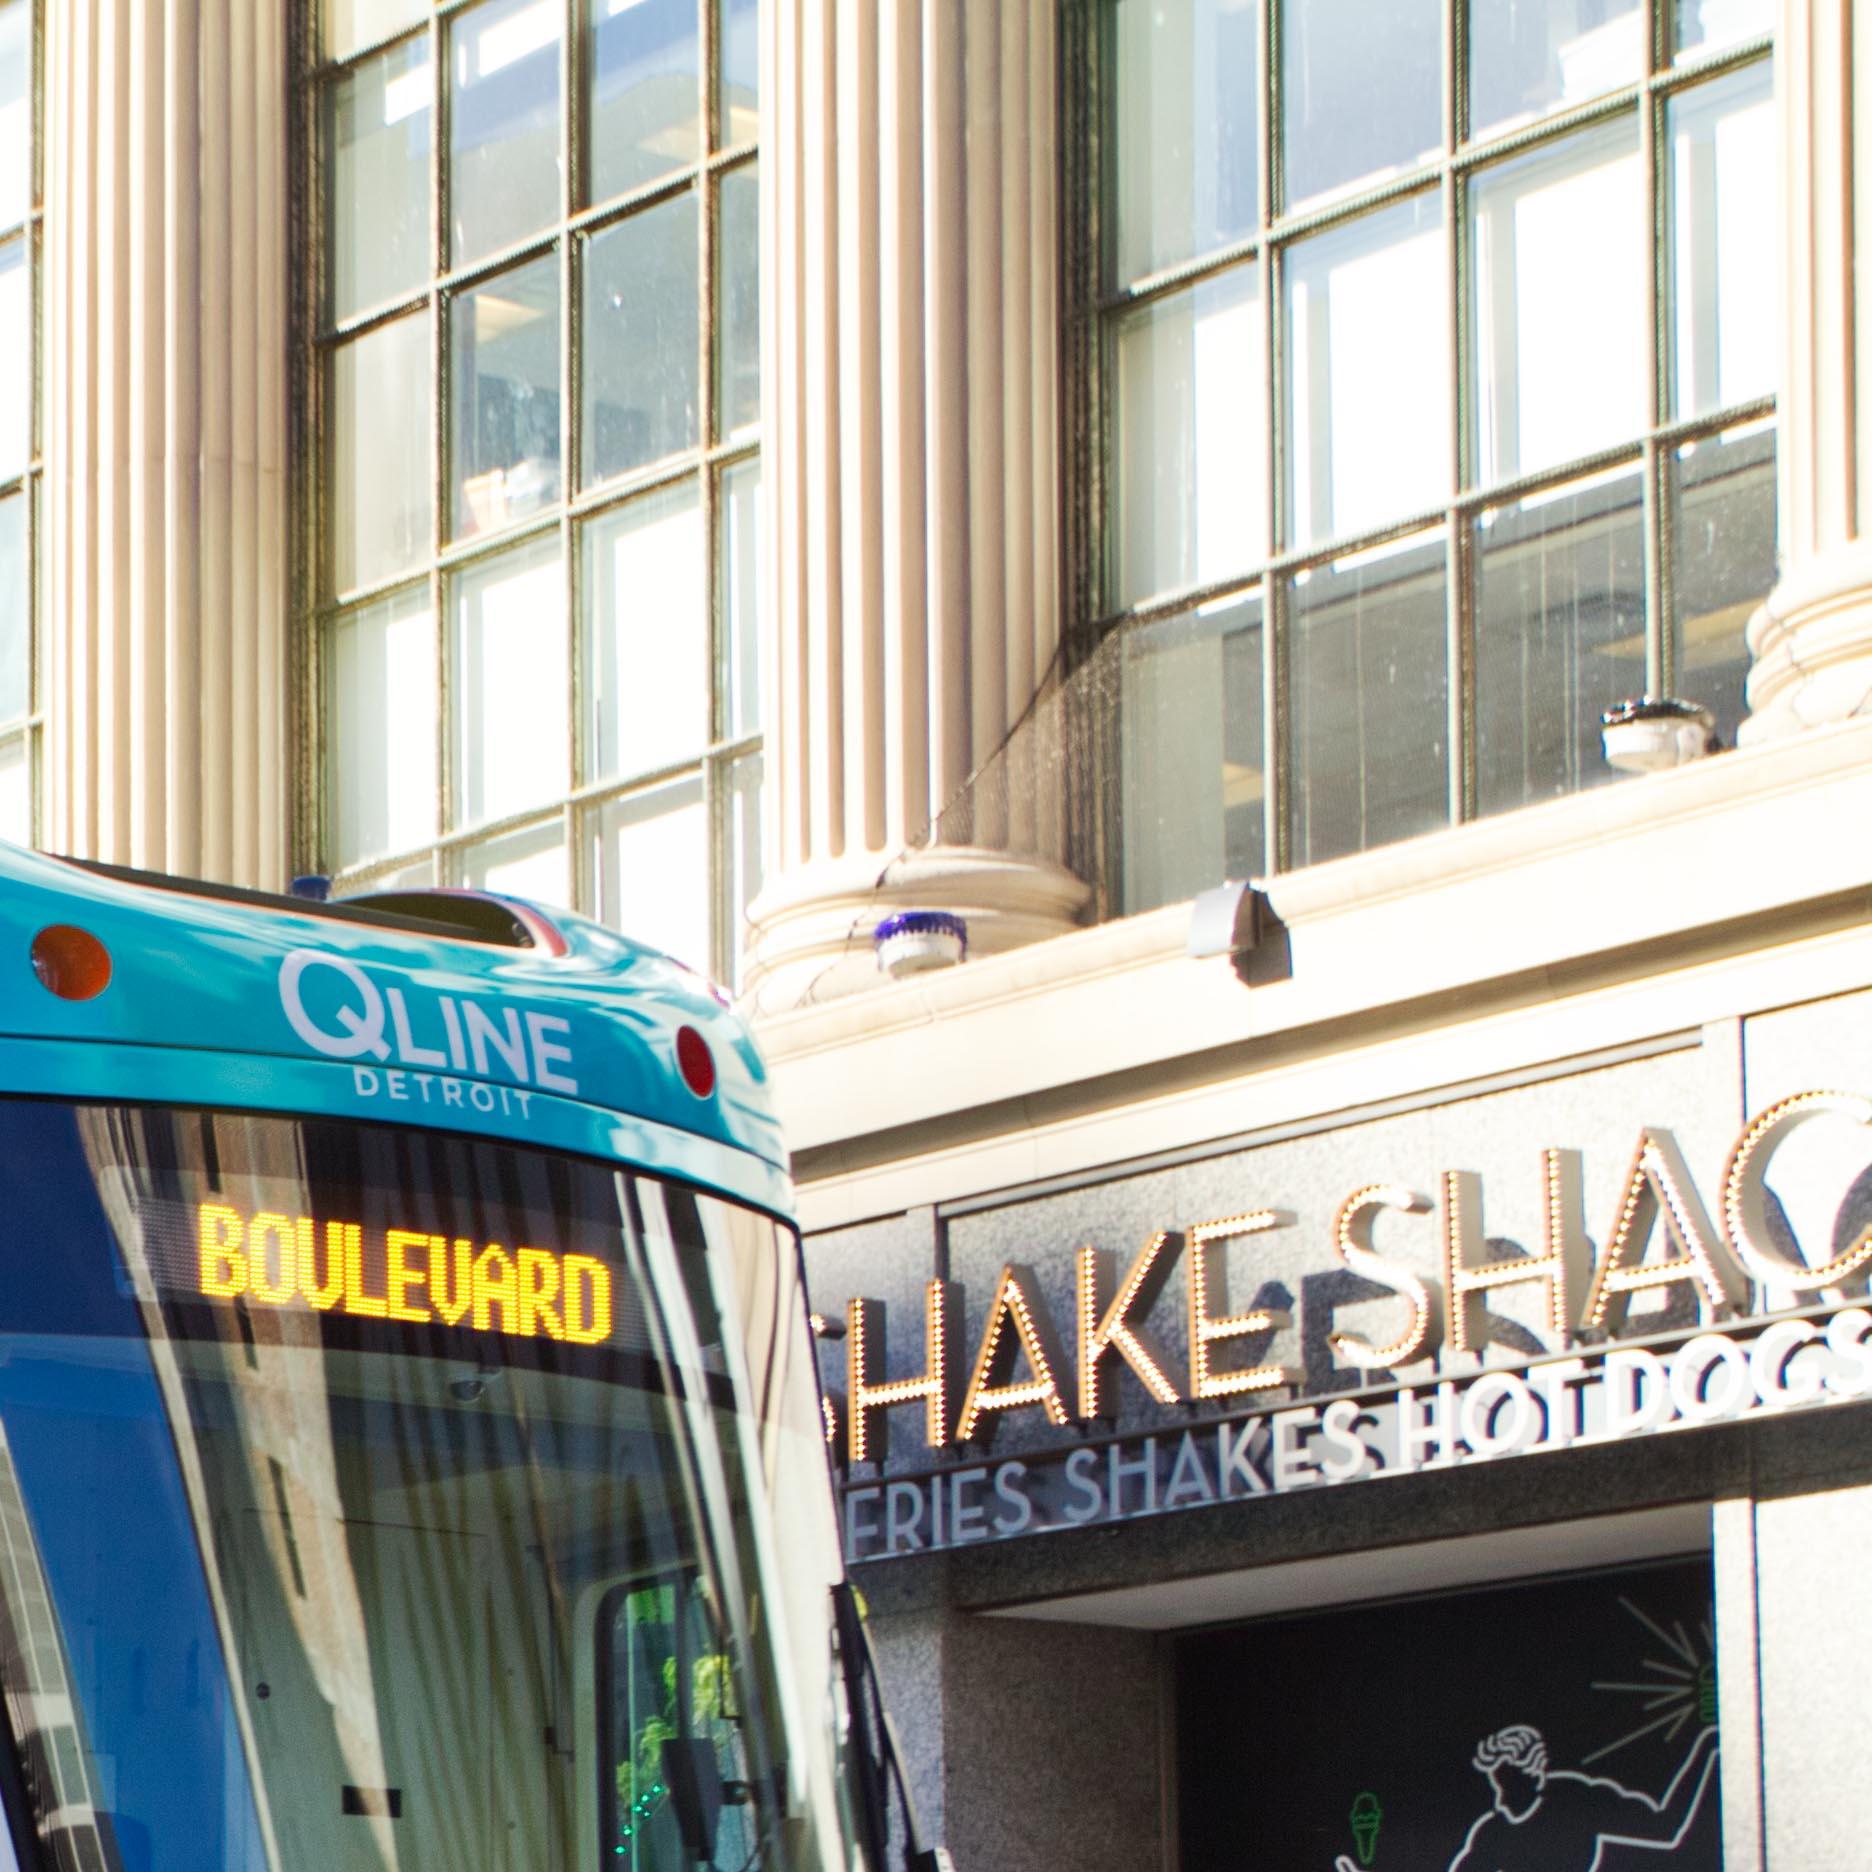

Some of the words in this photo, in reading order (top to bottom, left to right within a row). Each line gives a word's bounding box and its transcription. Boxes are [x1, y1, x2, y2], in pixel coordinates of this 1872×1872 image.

[278, 947, 579, 1095] QLINE
[356, 1066, 533, 1120] DETROIT
[198, 1203, 612, 1345] BOULEVARD
[809, 1208, 1304, 1462] HAKE
[844, 1461, 1031, 1564] FRIES
[1063, 1400, 1366, 1524] SHAKES
